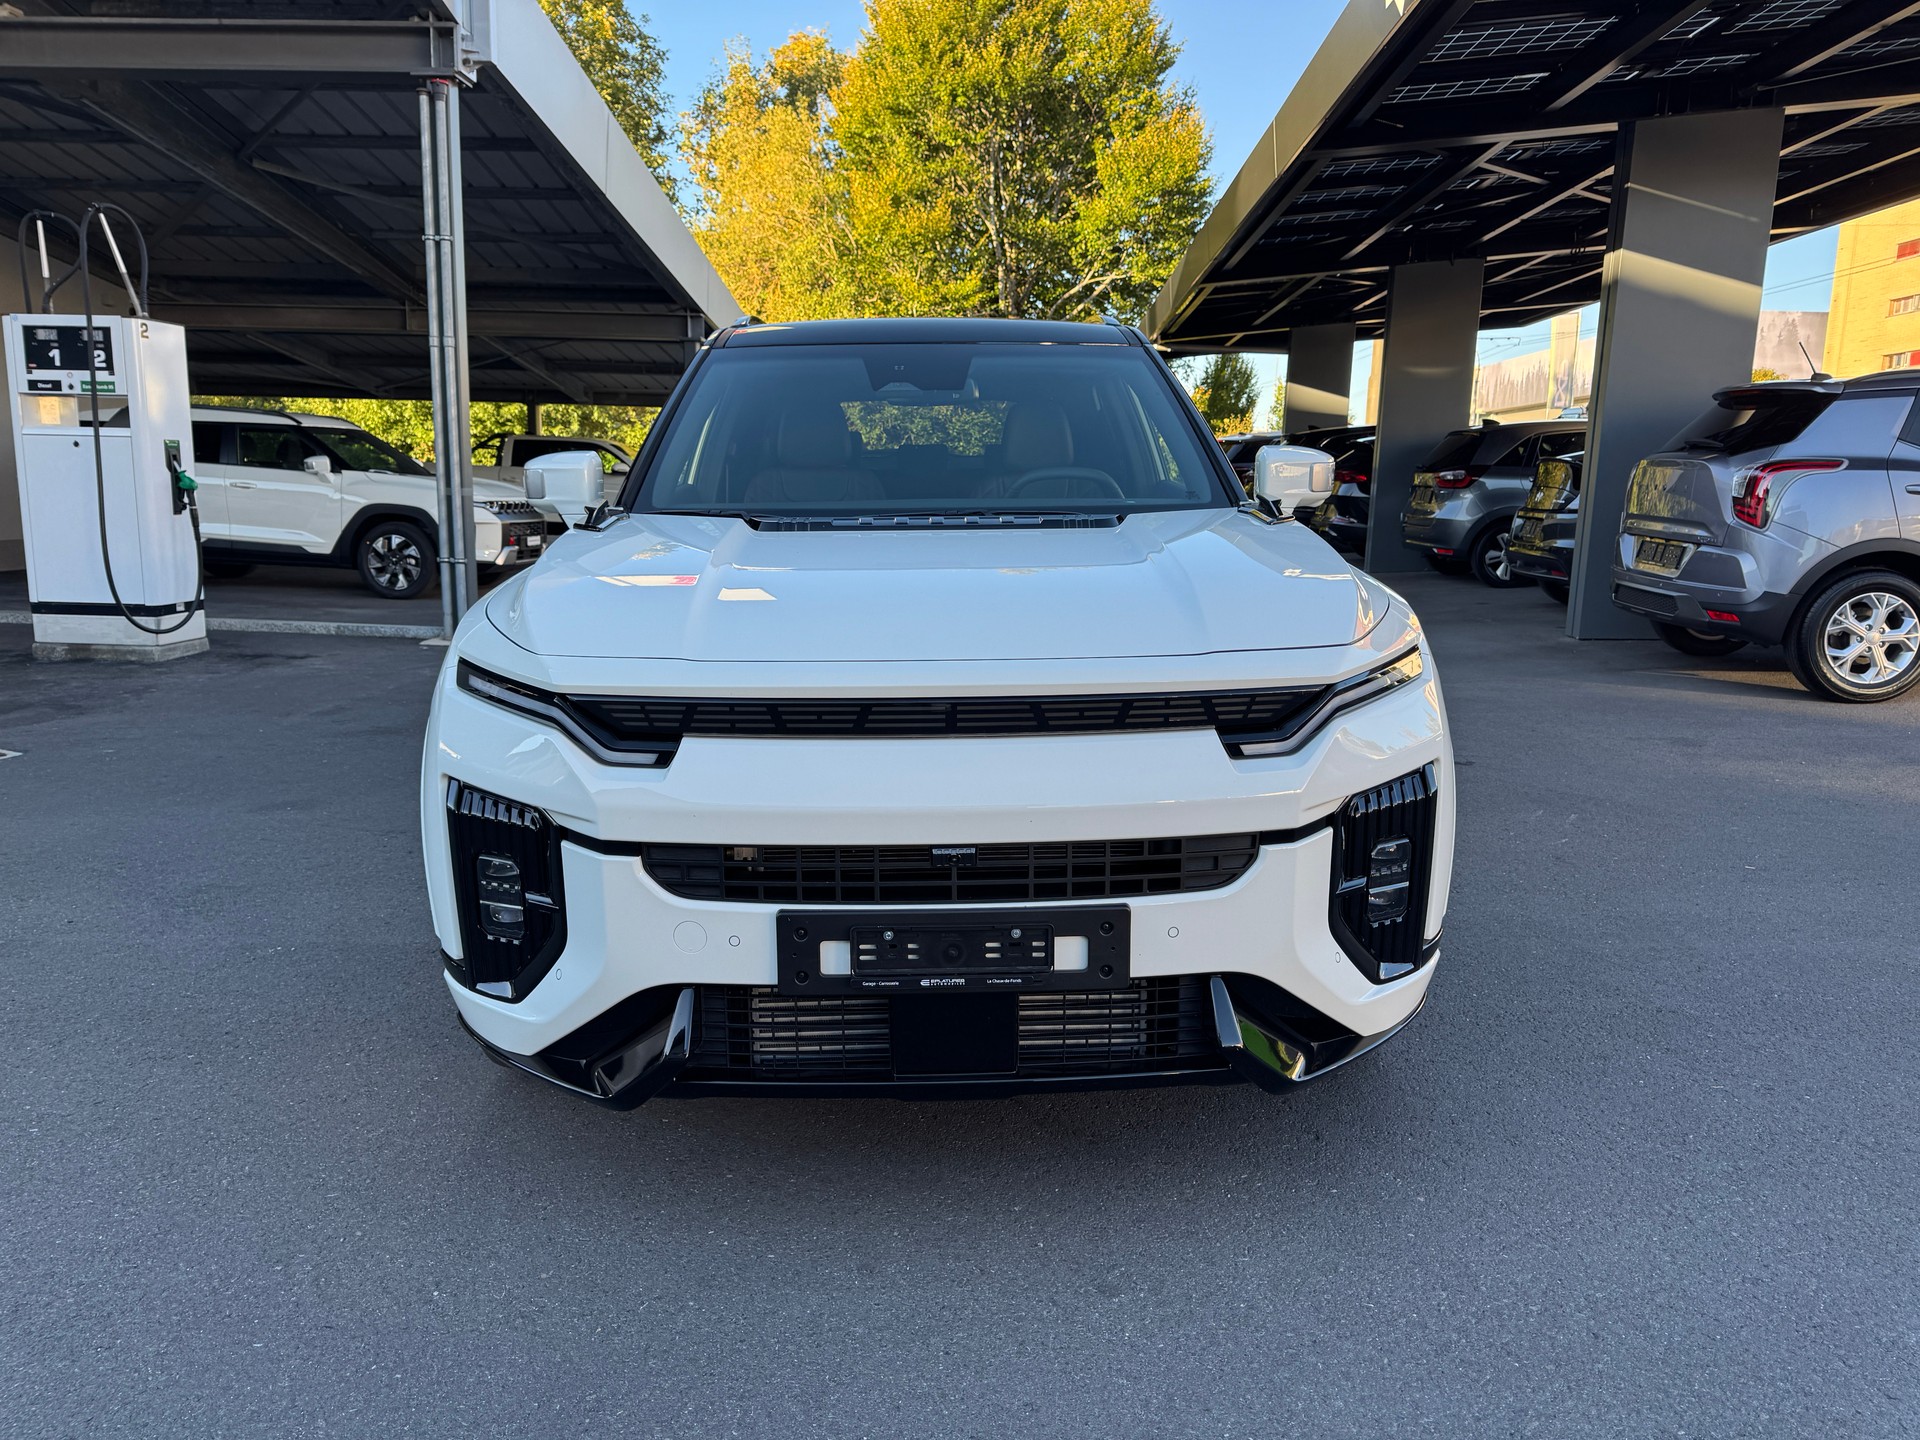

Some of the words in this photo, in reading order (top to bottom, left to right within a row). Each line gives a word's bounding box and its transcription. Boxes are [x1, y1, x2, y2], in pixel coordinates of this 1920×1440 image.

[140, 322, 149, 339] 2
[48, 348, 61, 366] 1
[94, 349, 107, 368] 2
